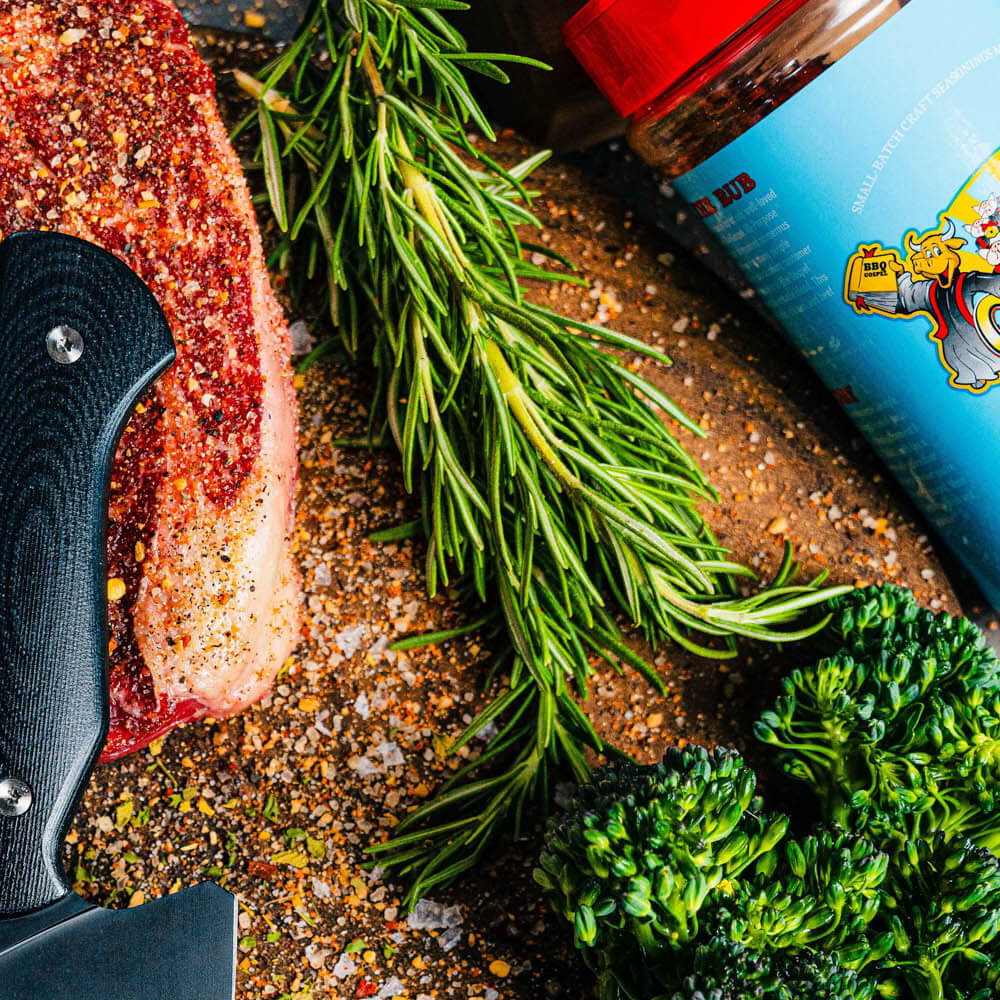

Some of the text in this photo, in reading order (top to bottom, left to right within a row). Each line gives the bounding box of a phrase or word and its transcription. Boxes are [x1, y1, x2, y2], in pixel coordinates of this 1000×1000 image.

[851, 174, 878, 215] SMALL
[872, 129, 905, 172] BATCH
[900, 92, 935, 132] CRAFT
[712, 172, 756, 208] RUB
[863, 261, 887, 272] BBQ
